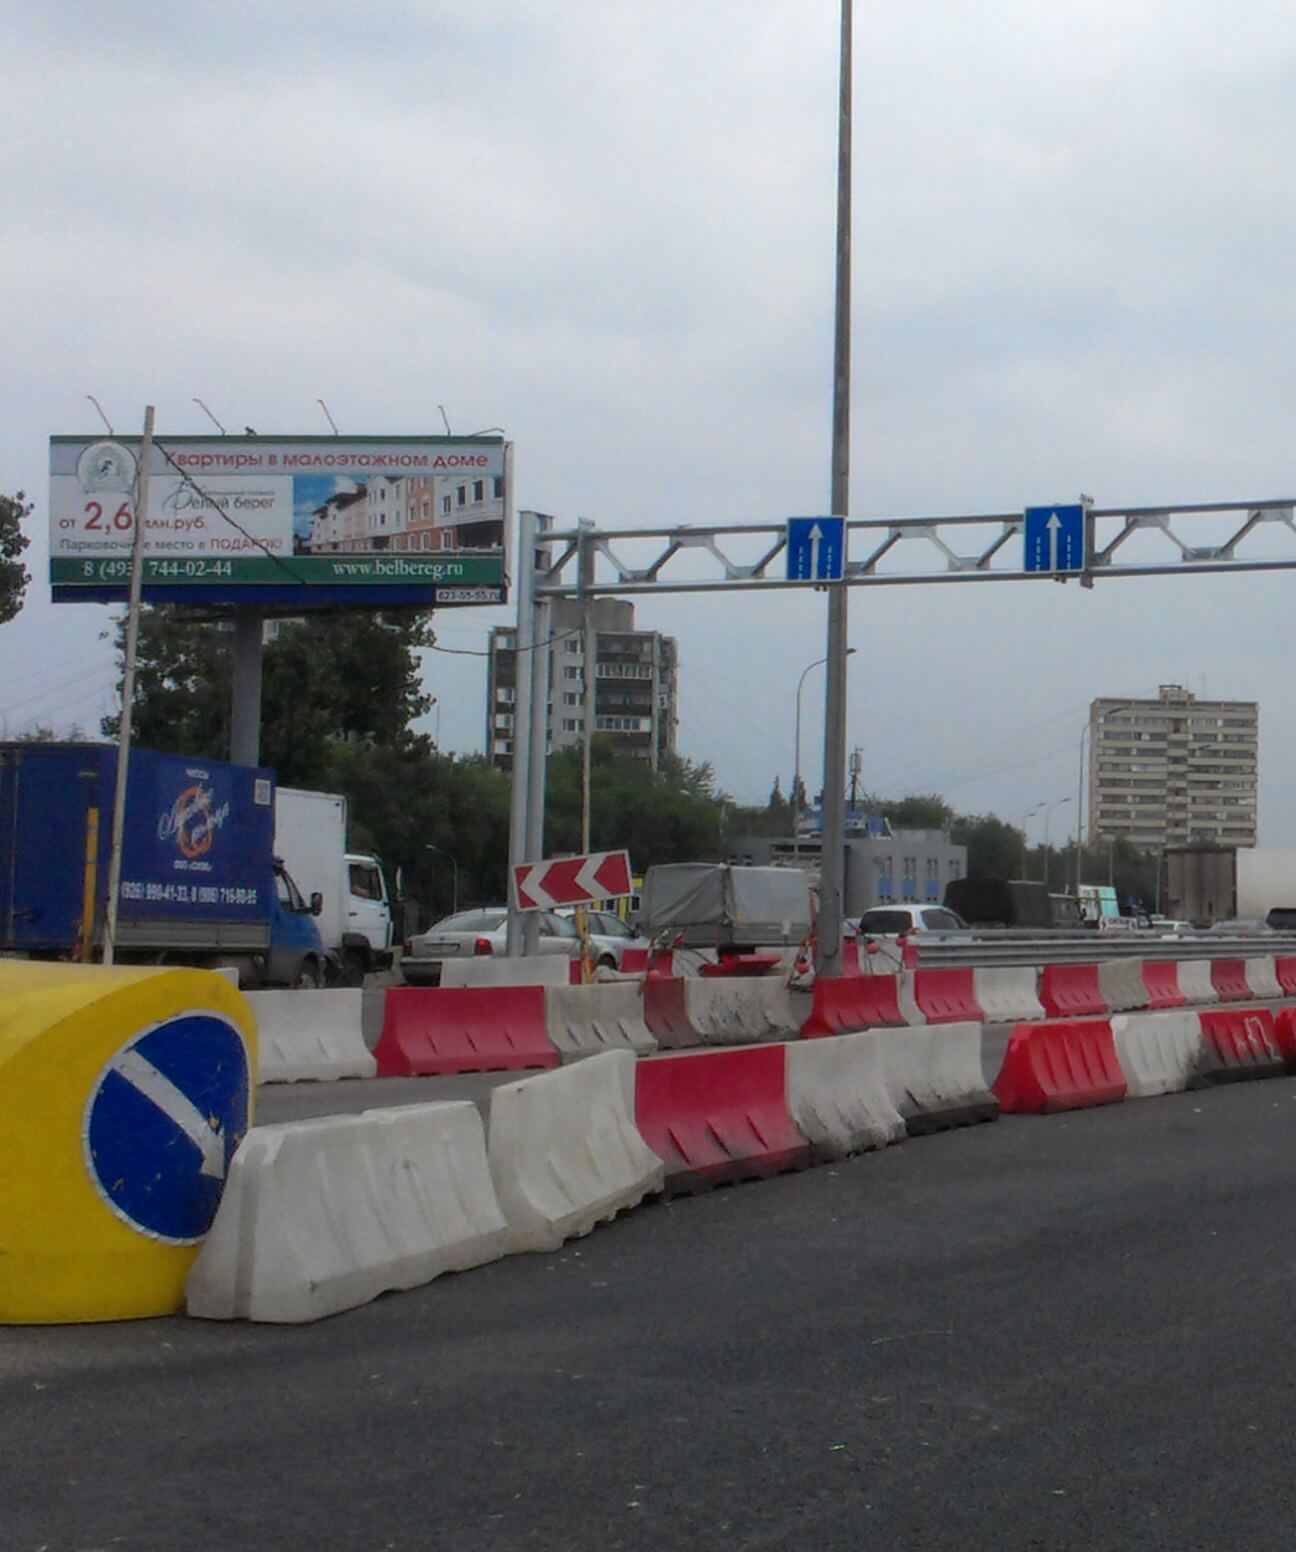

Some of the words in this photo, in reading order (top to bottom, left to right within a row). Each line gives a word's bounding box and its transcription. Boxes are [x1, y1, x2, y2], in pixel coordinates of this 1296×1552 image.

[165, 451, 262, 470] Квартиры
[267, 454, 277, 466] в
[283, 453, 428, 467] малоэтажном
[433, 453, 488, 468] доме
[233, 495, 274, 510] берег
[59, 518, 76, 529] от
[84, 501, 132, 534] 2,6
[60, 538, 149, 552] Парковочне
[155, 542, 194, 551] место
[210, 538, 282, 552] ПОДАРОК!
[84, 561, 94, 577] 8
[150, 560, 232, 577] 744-02-44
[333, 560, 463, 580] www.belbereg.ru
